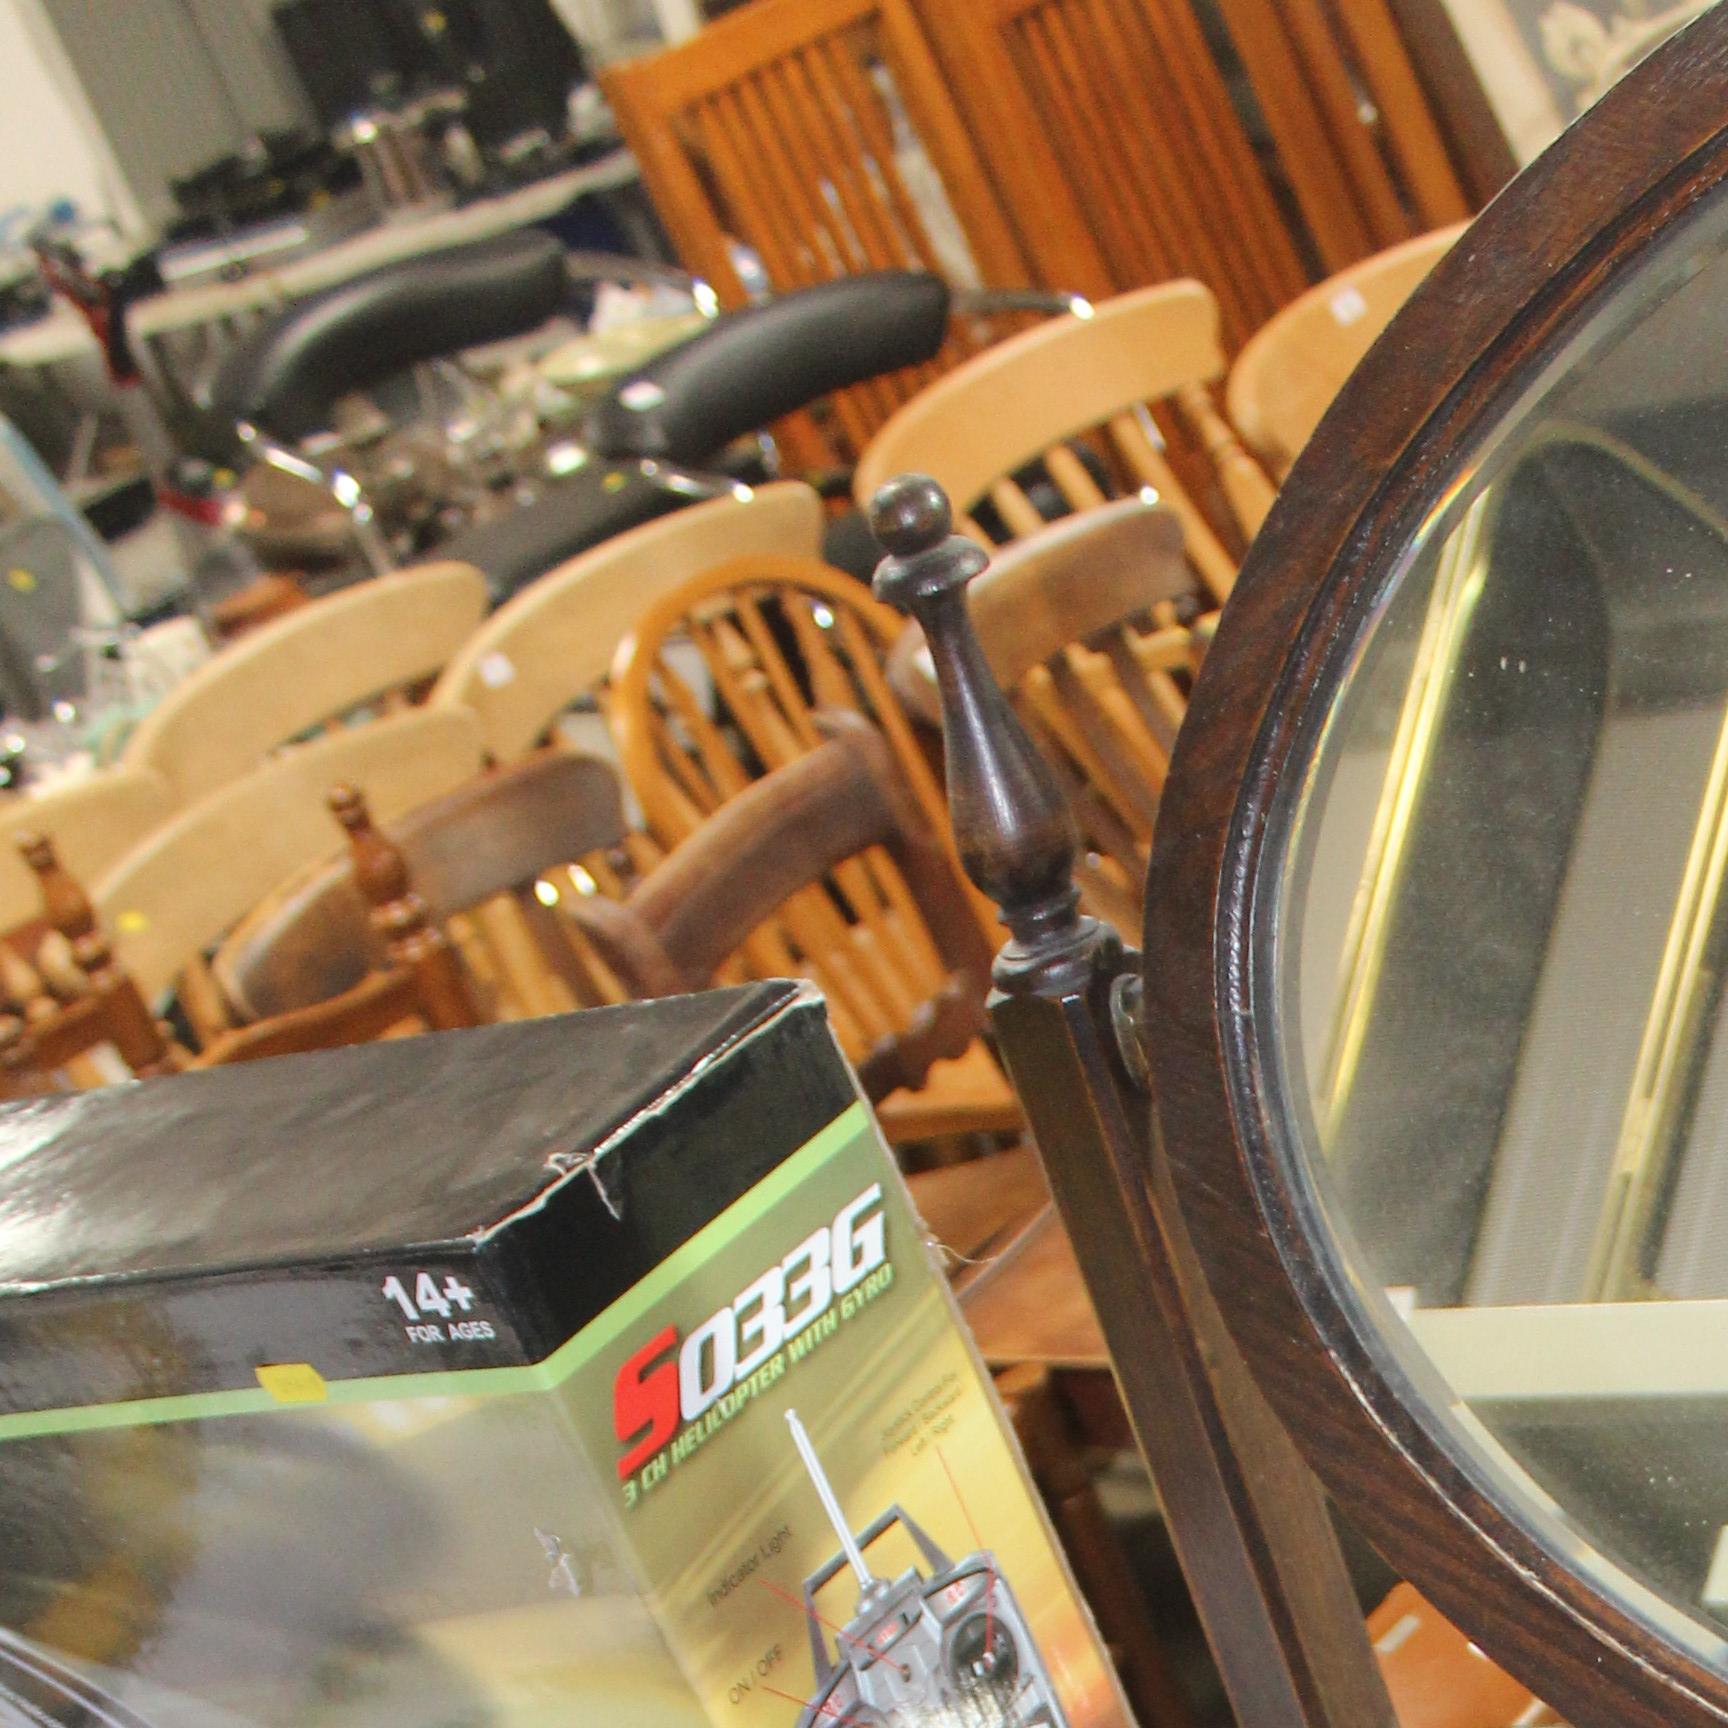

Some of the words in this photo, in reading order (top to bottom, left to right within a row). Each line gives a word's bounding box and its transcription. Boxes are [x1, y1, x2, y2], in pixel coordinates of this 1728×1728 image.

[382, 1271, 475, 1320] 14+
[404, 1325, 447, 1343] FOR
[447, 1320, 496, 1341] AGES
[621, 1477, 639, 1510] 3
[641, 1457, 669, 1492] CH
[670, 1352, 788, 1466] HELICOPTER
[787, 1307, 838, 1364] WITH
[840, 1262, 896, 1320] GYRO
